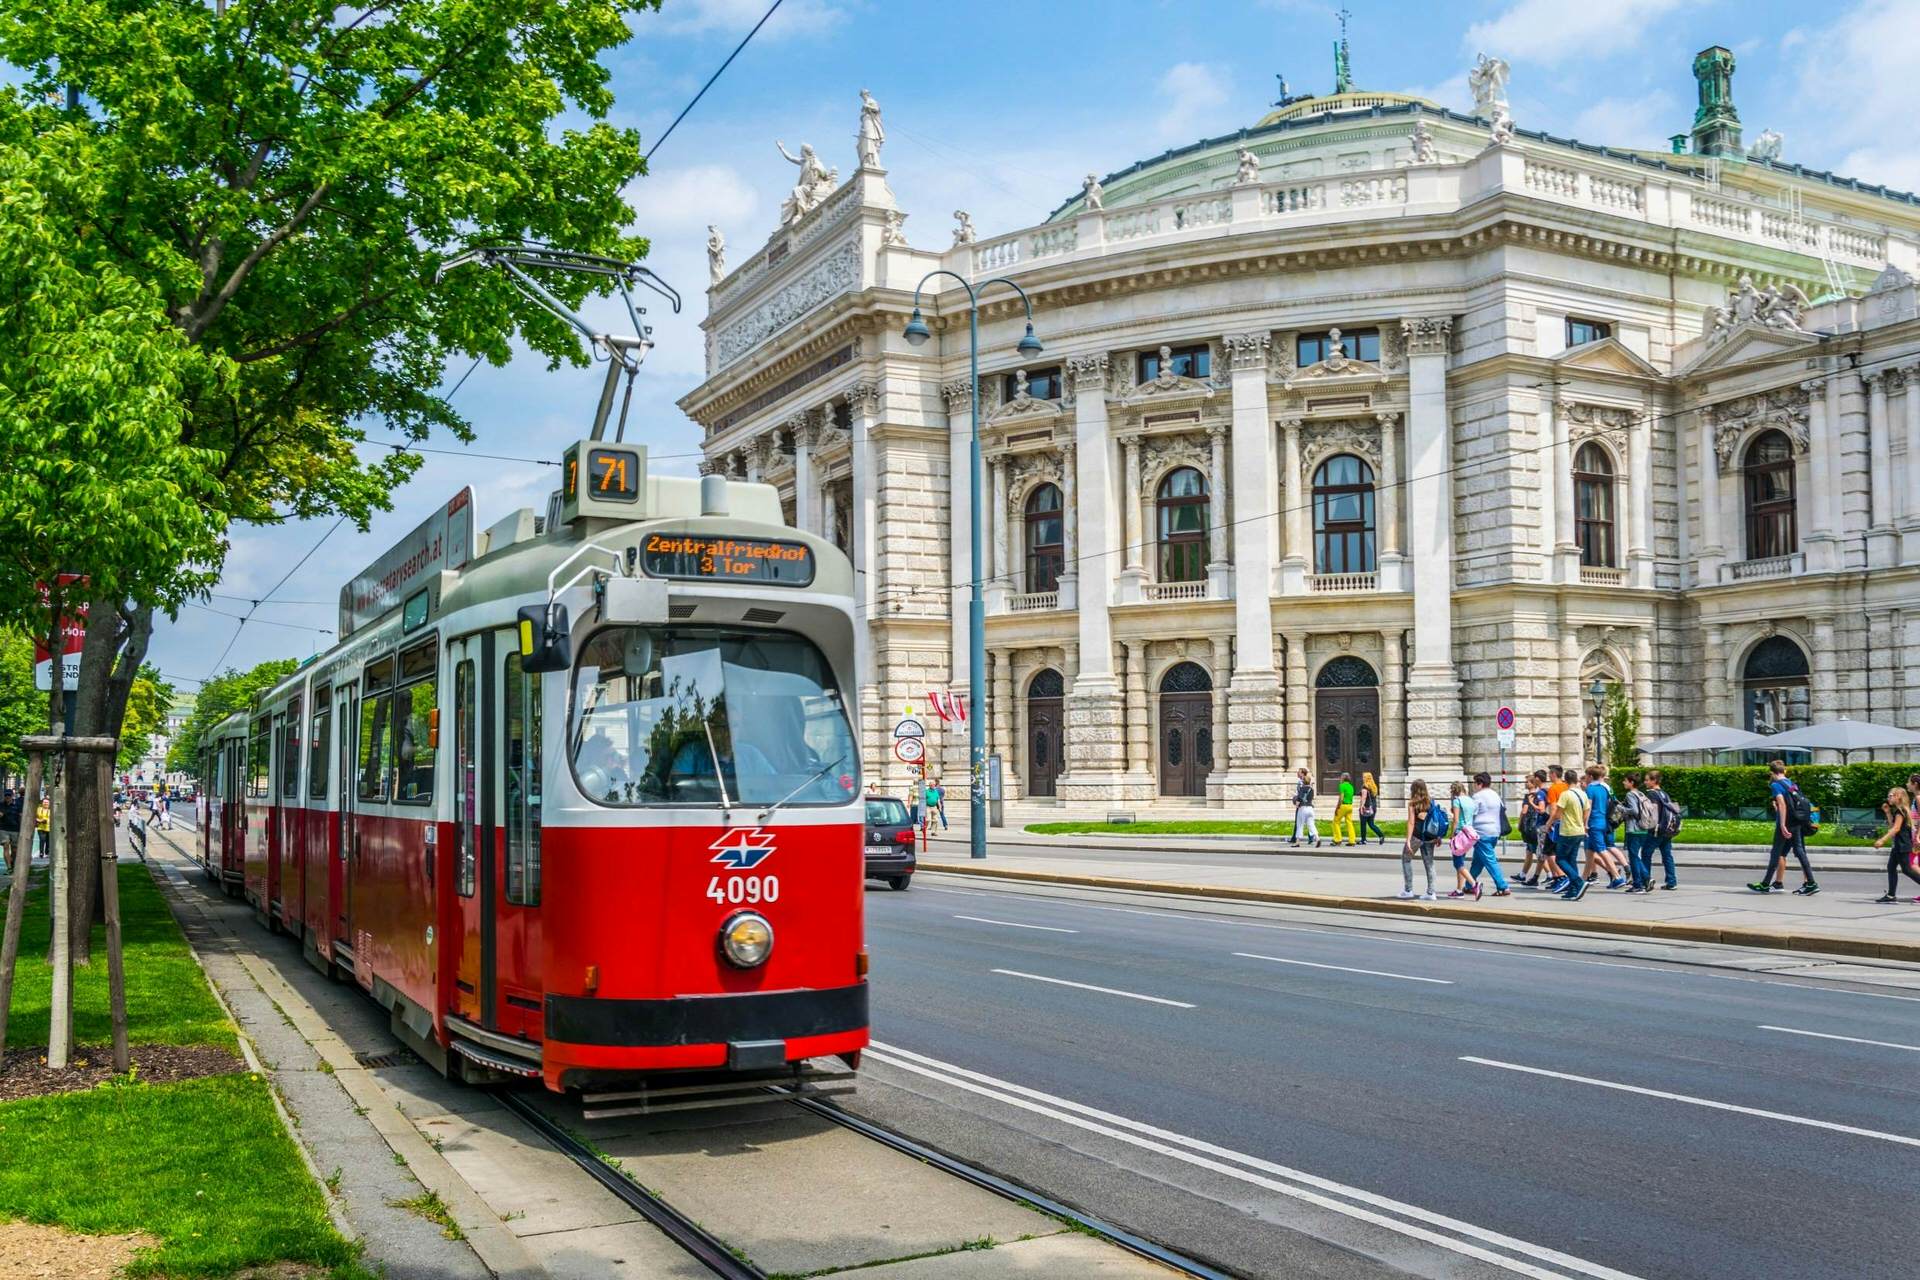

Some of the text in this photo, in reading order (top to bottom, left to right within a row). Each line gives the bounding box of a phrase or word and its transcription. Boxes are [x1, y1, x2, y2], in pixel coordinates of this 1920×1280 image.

[597, 456, 625, 492] 71
[647, 535, 808, 561] Zentralfriedhof
[701, 556, 756, 575] 3. Tor
[706, 875, 779, 904] 4090
